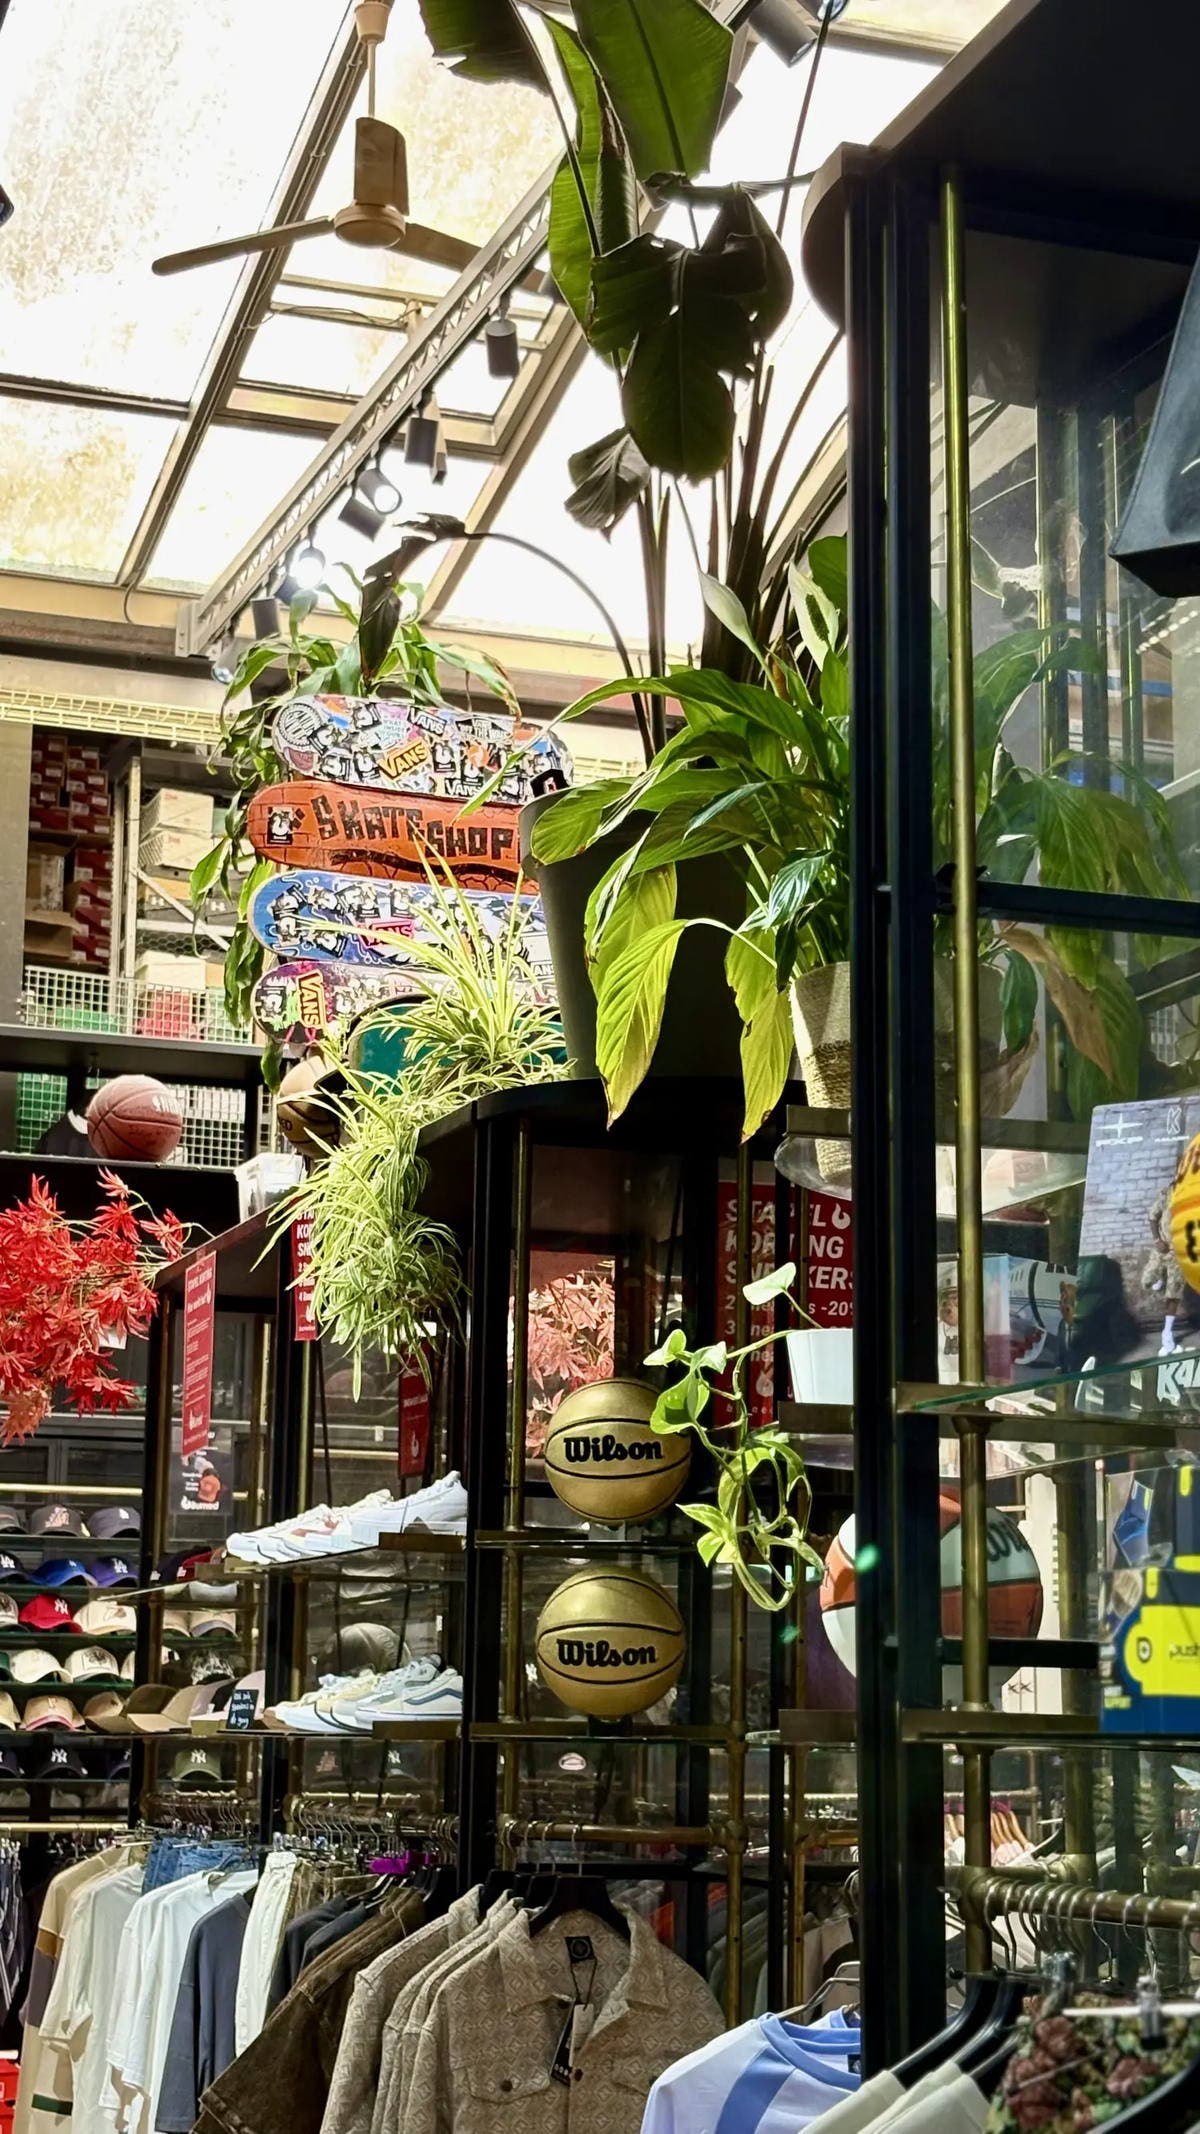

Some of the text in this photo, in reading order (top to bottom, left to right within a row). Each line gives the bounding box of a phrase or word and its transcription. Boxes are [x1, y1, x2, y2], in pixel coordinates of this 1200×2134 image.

[408, 706, 446, 736] VANS
[378, 742, 428, 779] VANS
[299, 972, 321, 1026] VANS
[821, 1300, 853, 1316] -20
[564, 1434, 665, 1463] Wilson
[556, 1638, 658, 1668] Wilson
